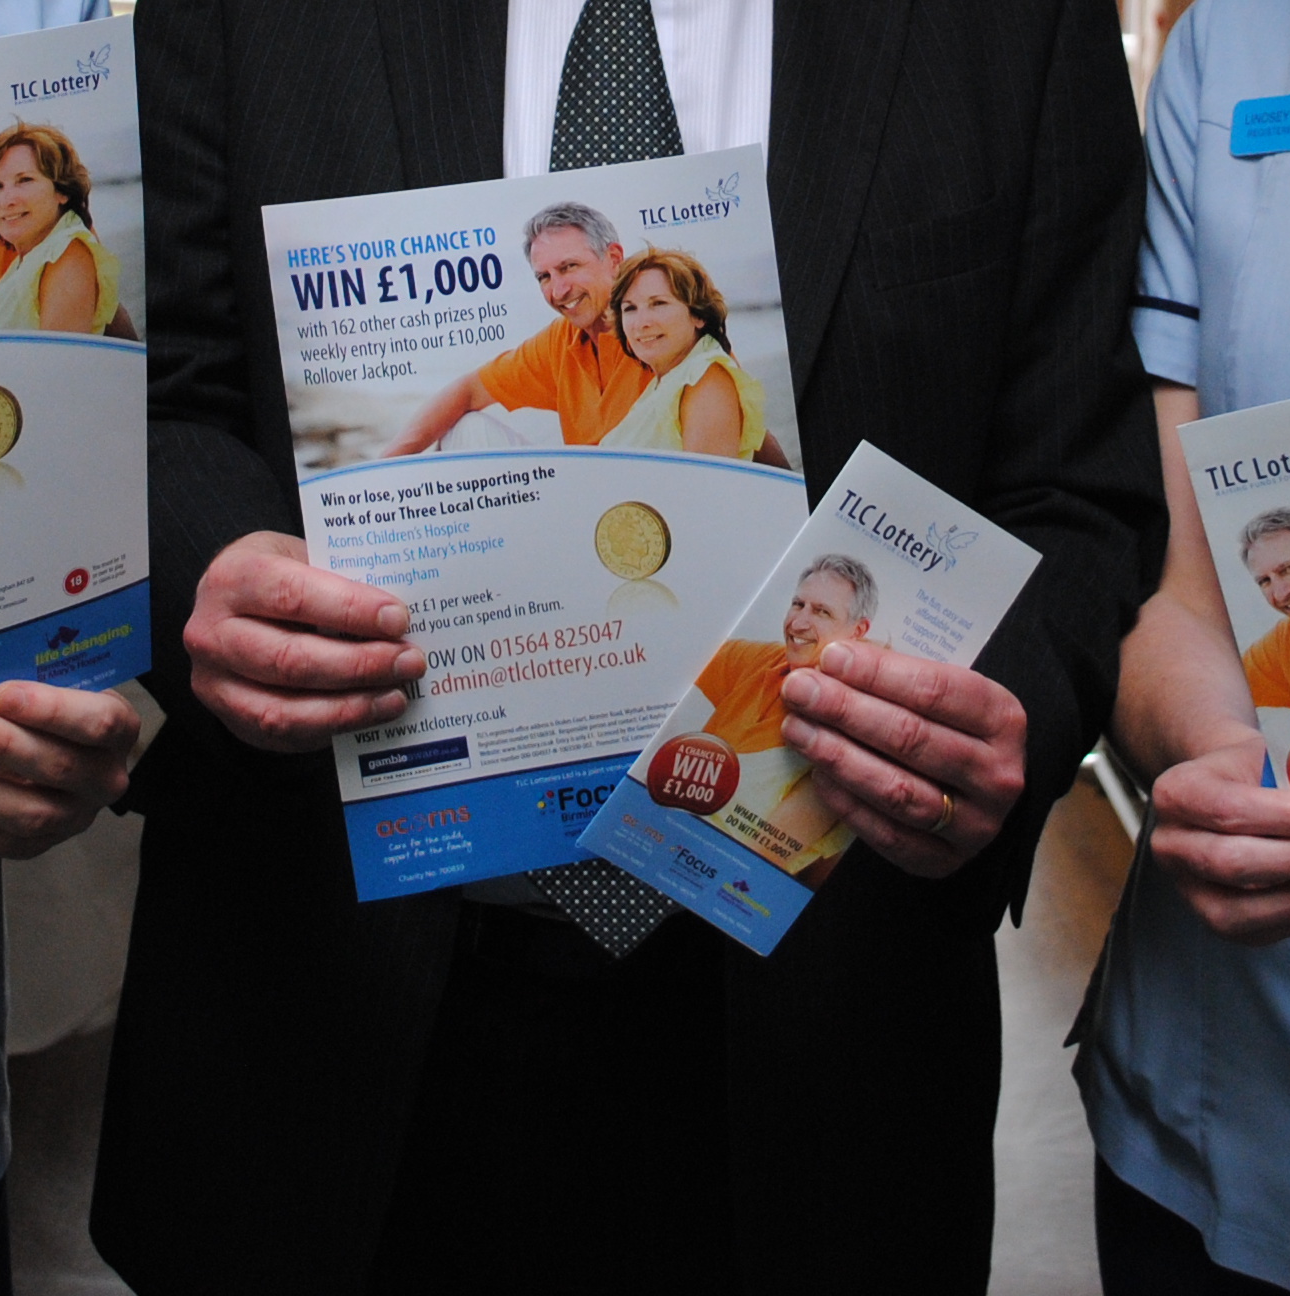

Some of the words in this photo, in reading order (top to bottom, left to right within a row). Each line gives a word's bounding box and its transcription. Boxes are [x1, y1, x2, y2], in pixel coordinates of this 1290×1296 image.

[11, 81, 38, 100] TLC
[43, 73, 99, 90] Lottery
[639, 207, 667, 225] TLC
[672, 201, 729, 217] Lottery
[288, 244, 346, 268] HERE'S
[348, 239, 397, 262] YOUR
[400, 230, 470, 256] CHANCE
[473, 227, 496, 246] TO
[291, 268, 366, 311] WIN
[377, 253, 503, 304] £1,000
[297, 322, 327, 339] with
[332, 318, 356, 335] 162
[360, 315, 395, 333] other
[400, 309, 430, 328] cash
[434, 307, 474, 329] prizes
[479, 301, 508, 323] plus
[301, 343, 347, 362] weekly
[351, 341, 386, 357] entry
[390, 337, 417, 352] into
[422, 334, 444, 349] our
[449, 324, 504, 346] £10,000
[304, 366, 357, 385] Rollover
[362, 360, 417, 381] Jackpot.
[320, 493, 345, 507] Win
[349, 494, 361, 505] or
[364, 489, 395, 503] lose,
[398, 482, 434, 500] you'll
[437, 482, 453, 494] be
[456, 471, 530, 493] supporting
[533, 466, 555, 479] the
[1205, 461, 1248, 490] TLC
[324, 512, 355, 527] work
[359, 511, 370, 525] of
[374, 510, 396, 523] our
[398, 504, 437, 520] Three
[440, 498, 474, 515] Local
[477, 489, 541, 509] Charities:
[327, 535, 364, 548] Acorns
[366, 527, 422, 546] Children's
[424, 522, 470, 540] Hospice
[839, 489, 876, 525] TLC
[872, 513, 943, 572] Lottery
[330, 553, 401, 571] Birmingham
[404, 548, 415, 562] St
[418, 542, 457, 560] Mary's
[459, 537, 504, 554] Hospice
[366, 566, 439, 586] Birmingham
[423, 598, 436, 612] £1
[440, 596, 459, 611] per
[462, 589, 494, 605] week
[429, 617, 450, 633] you
[453, 615, 473, 626] can
[477, 605, 511, 625] spend
[515, 604, 526, 616] in
[529, 600, 564, 614] Brum.
[461, 644, 486, 663] ON
[491, 632, 549, 659] 01564
[555, 620, 622, 649] 825047
[431, 643, 646, 696] admin@tlclottery.co.uk
[354, 731, 380, 743] VISIT
[385, 706, 507, 739] www.tlclottery.co.uk
[672, 753, 723, 786] WIN
[685, 746, 715, 760] CHANCE
[716, 753, 726, 762] TO
[663, 779, 714, 802] £1,000
[725, 815, 736, 827] DO
[737, 822, 760, 841] WITH
[758, 835, 791, 859] £1,000?
[734, 804, 758, 822] WHAT
[758, 818, 786, 841] WOULD
[784, 836, 803, 852] YOU
